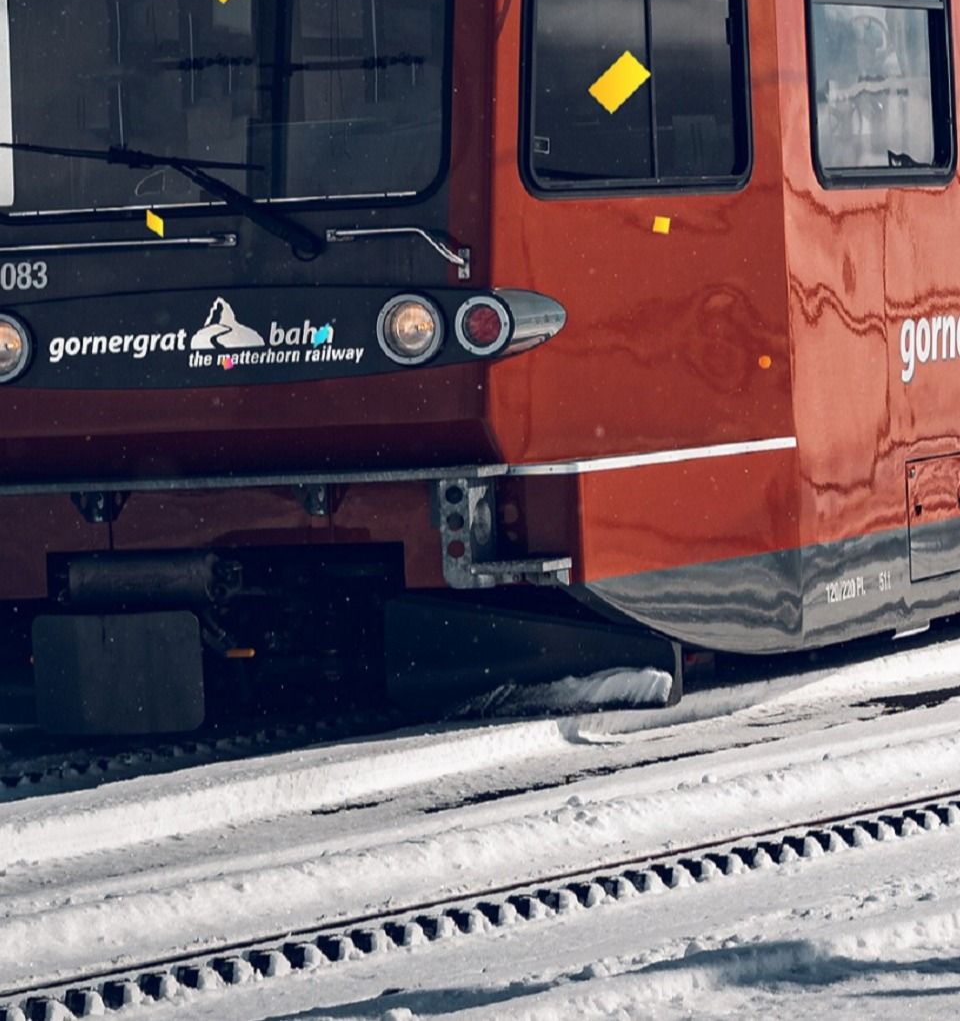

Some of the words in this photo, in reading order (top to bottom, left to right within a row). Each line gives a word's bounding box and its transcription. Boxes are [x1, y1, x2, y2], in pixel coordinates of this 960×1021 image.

[0, 261, 48, 290] 083
[49, 328, 187, 362] gornergrat
[189, 350, 213, 367] the
[217, 348, 300, 366] matterhorn
[304, 344, 364, 363] railway
